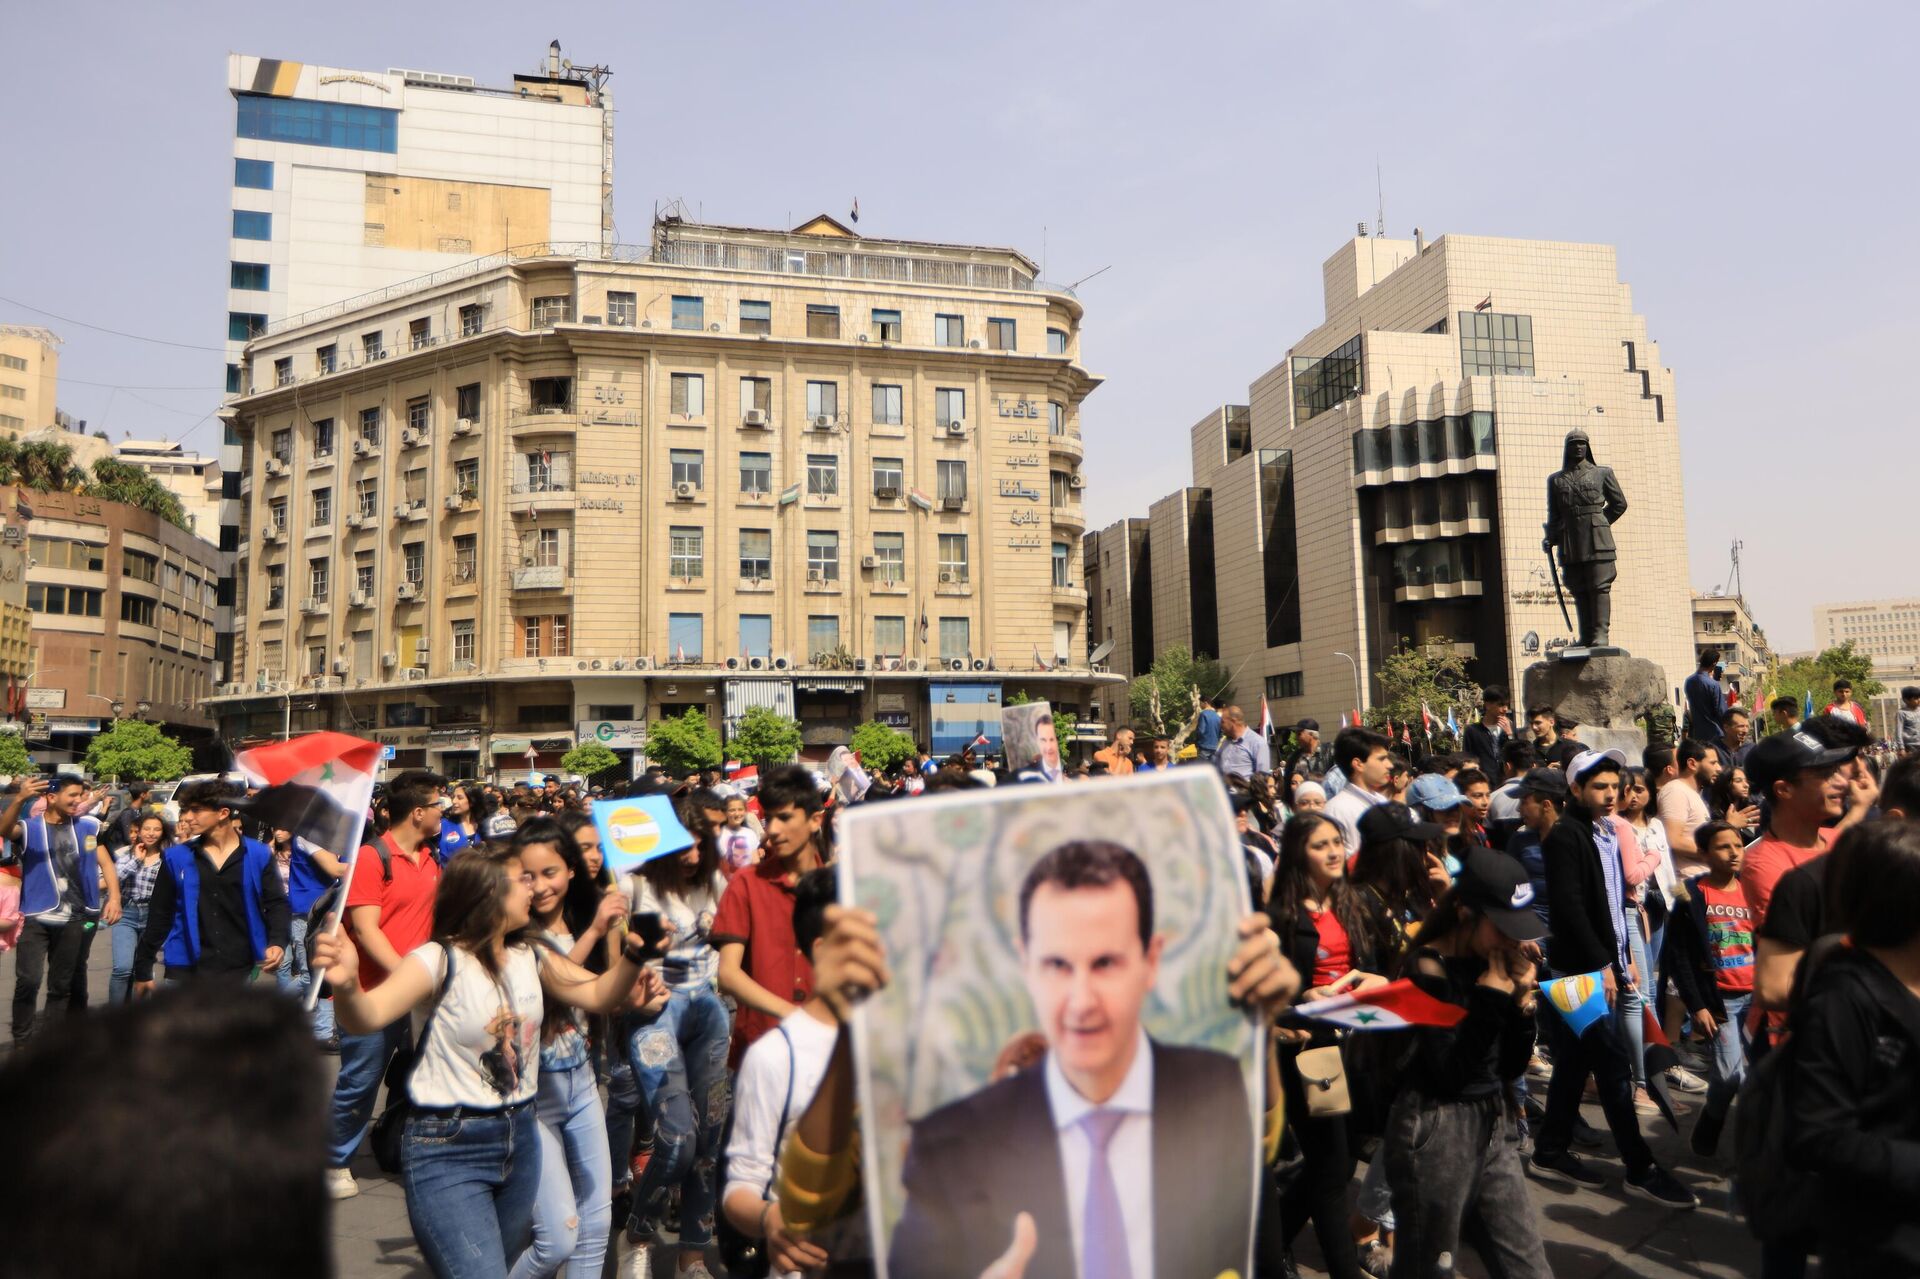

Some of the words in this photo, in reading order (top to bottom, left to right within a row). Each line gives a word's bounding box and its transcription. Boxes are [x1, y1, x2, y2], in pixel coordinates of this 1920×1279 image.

[595, 386, 624, 404] وزارة
[579, 472, 621, 488] Ministry
[579, 496, 625, 513] Housing
[1706, 904, 1751, 918] ACOST
